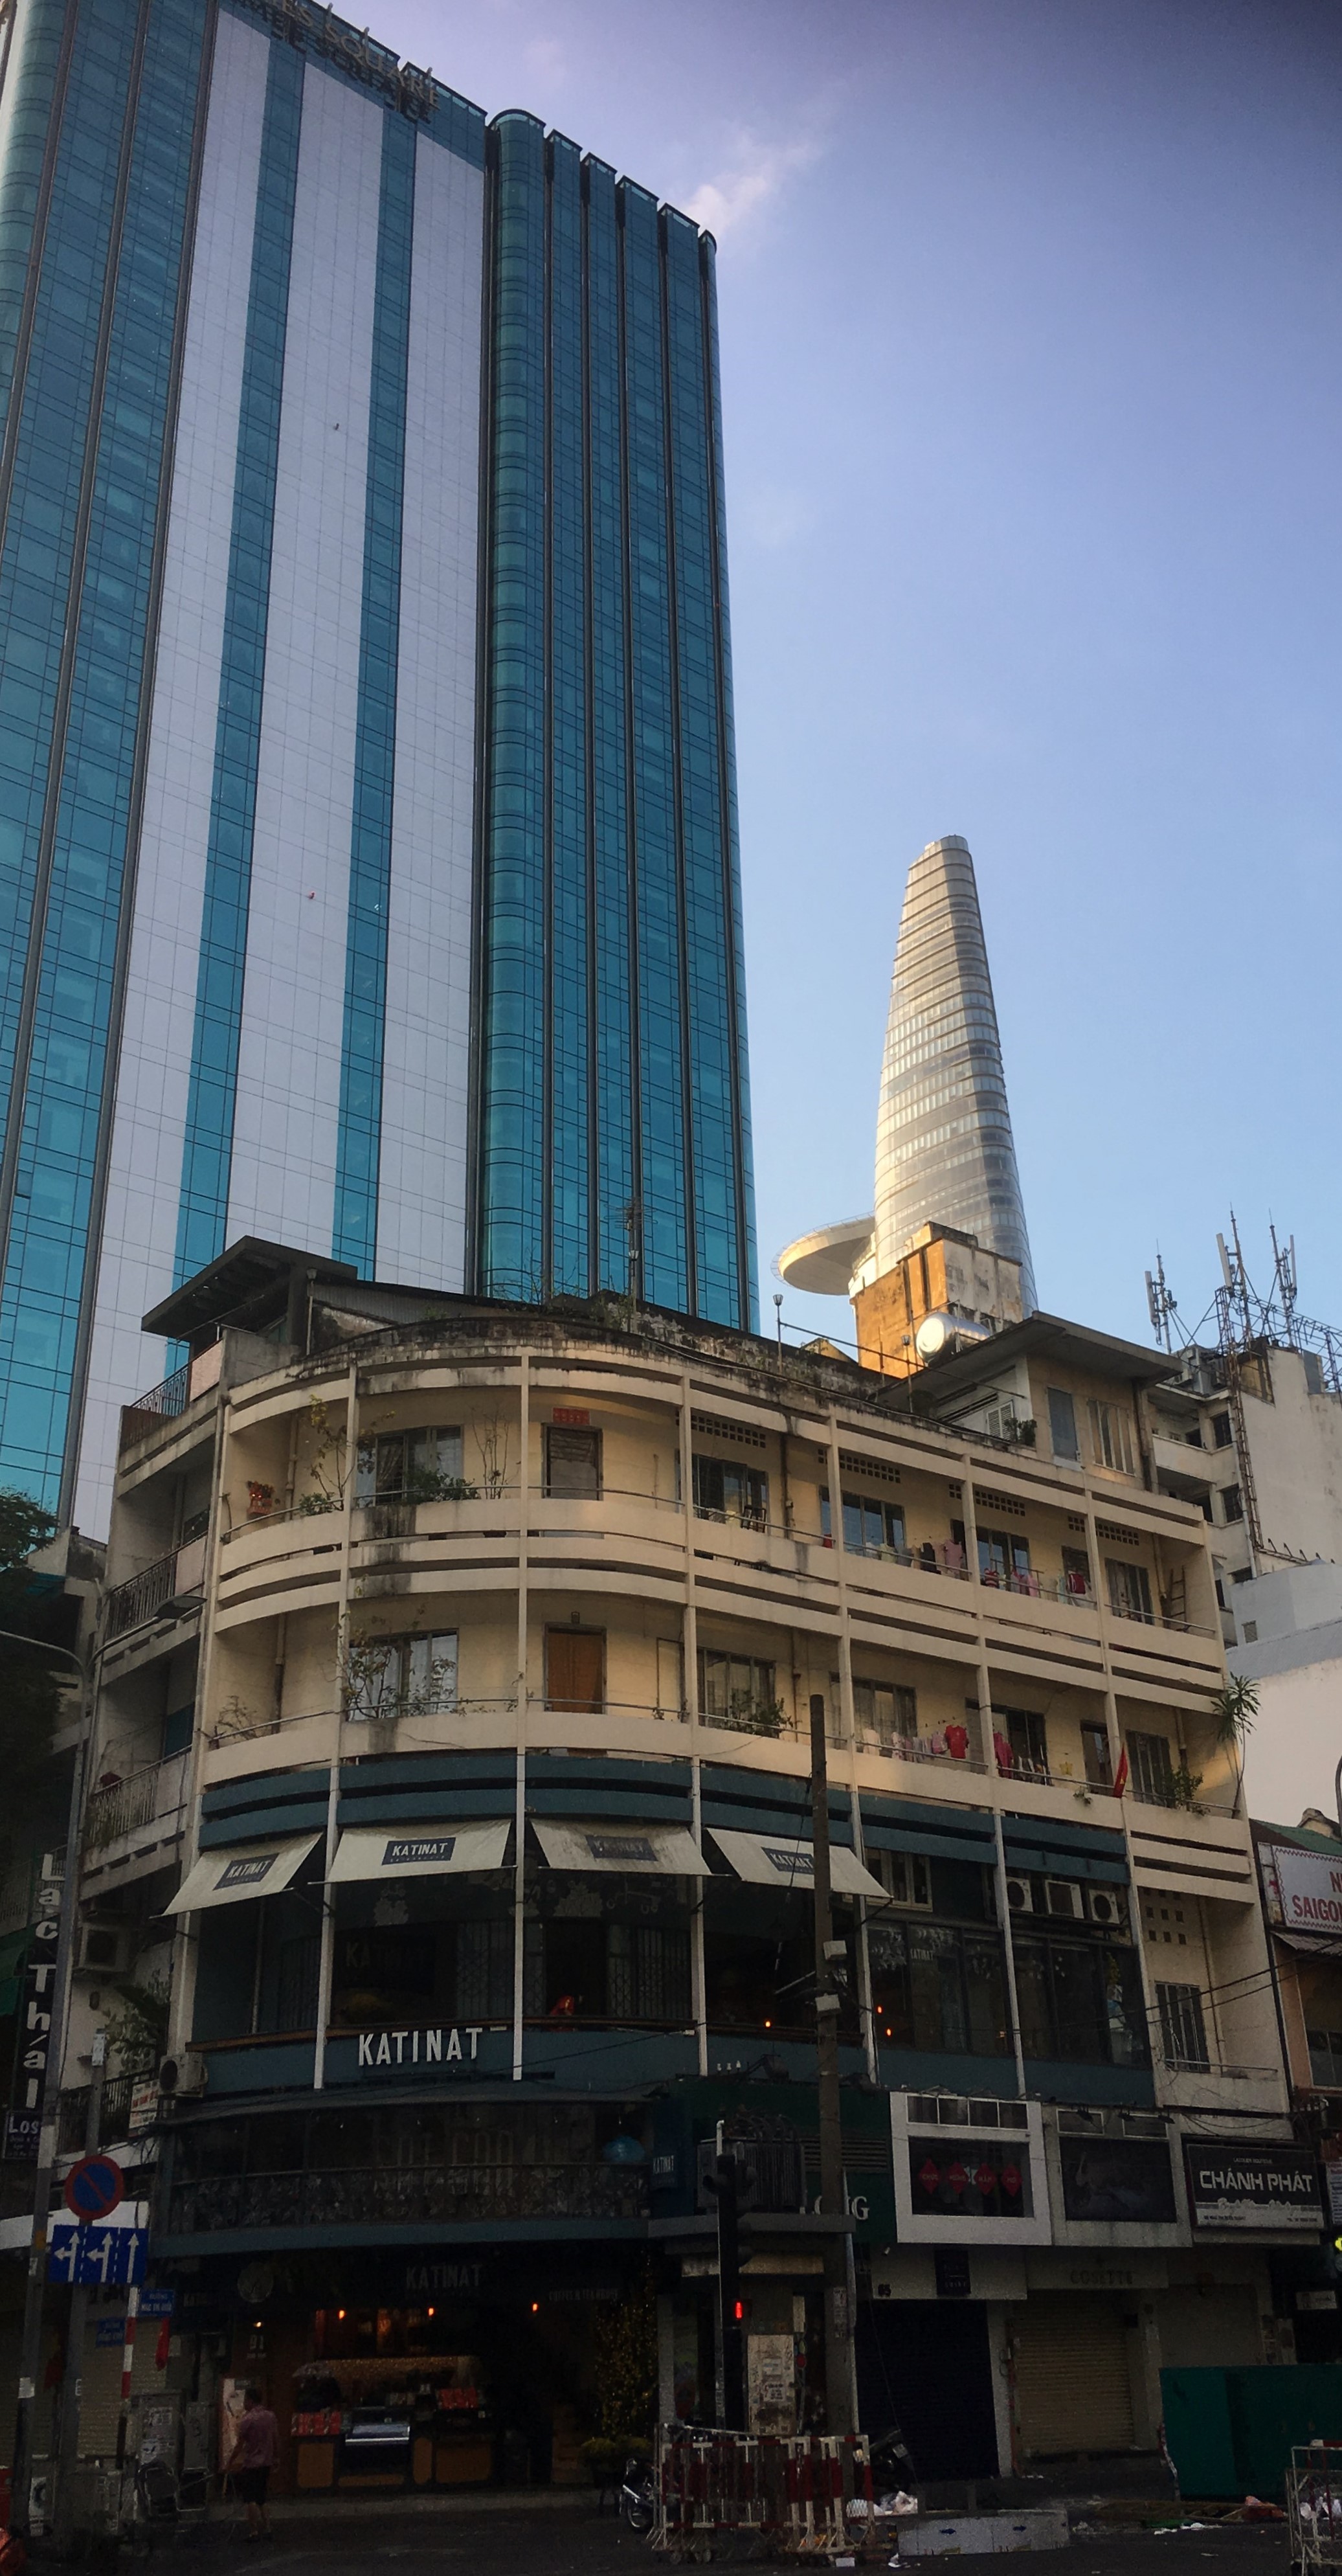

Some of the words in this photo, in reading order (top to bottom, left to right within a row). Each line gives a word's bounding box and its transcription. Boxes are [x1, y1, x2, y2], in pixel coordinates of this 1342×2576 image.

[325, 23, 441, 111] SQUARE
[392, 1842, 448, 1857] KATINAT
[227, 1860, 271, 1879] KATINAT
[770, 1853, 814, 1869] KATINAT
[1329, 1871, 1342, 1893] N
[359, 2028, 483, 2066] KATINAT
[1267, 2170, 1313, 2193] PHÁT
[406, 2264, 484, 2290] KATINAT
